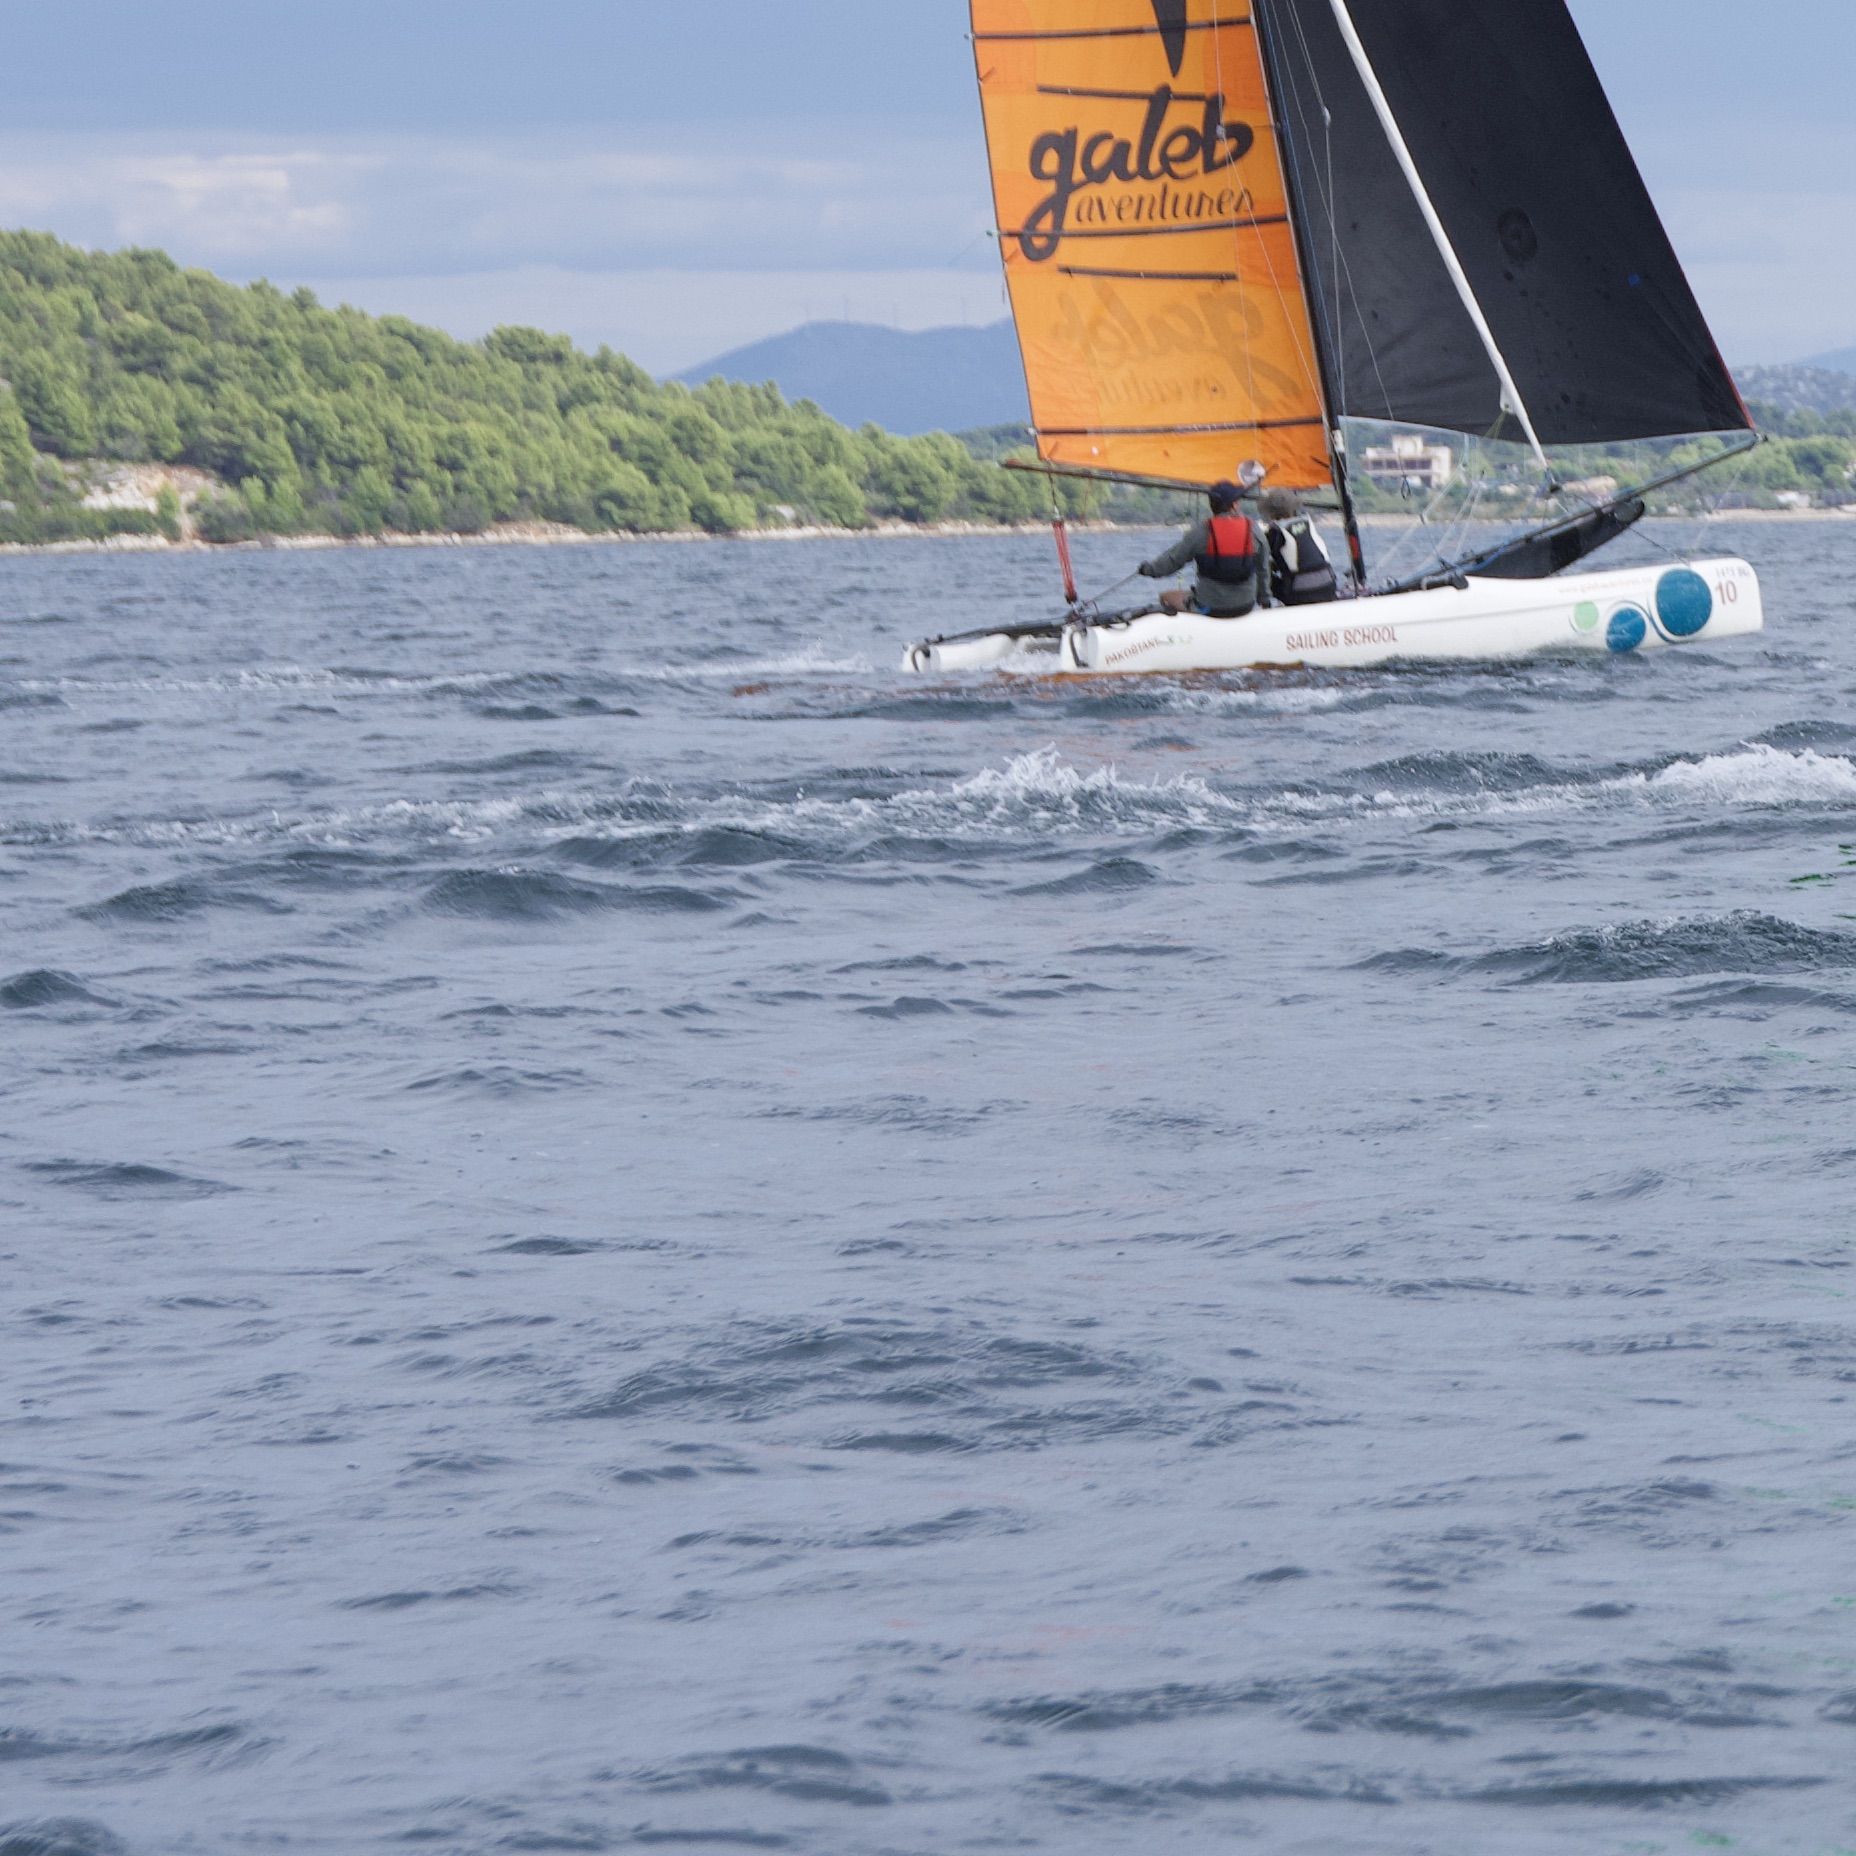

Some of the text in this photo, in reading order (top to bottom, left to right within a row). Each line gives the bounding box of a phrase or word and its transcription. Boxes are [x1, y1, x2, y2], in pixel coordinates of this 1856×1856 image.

[1018, 84, 1254, 262] galeb
[1074, 183, 1254, 225] aventures
[1715, 580, 1737, 605] 10
[1286, 625, 1398, 651] SAILING SCHOOL
